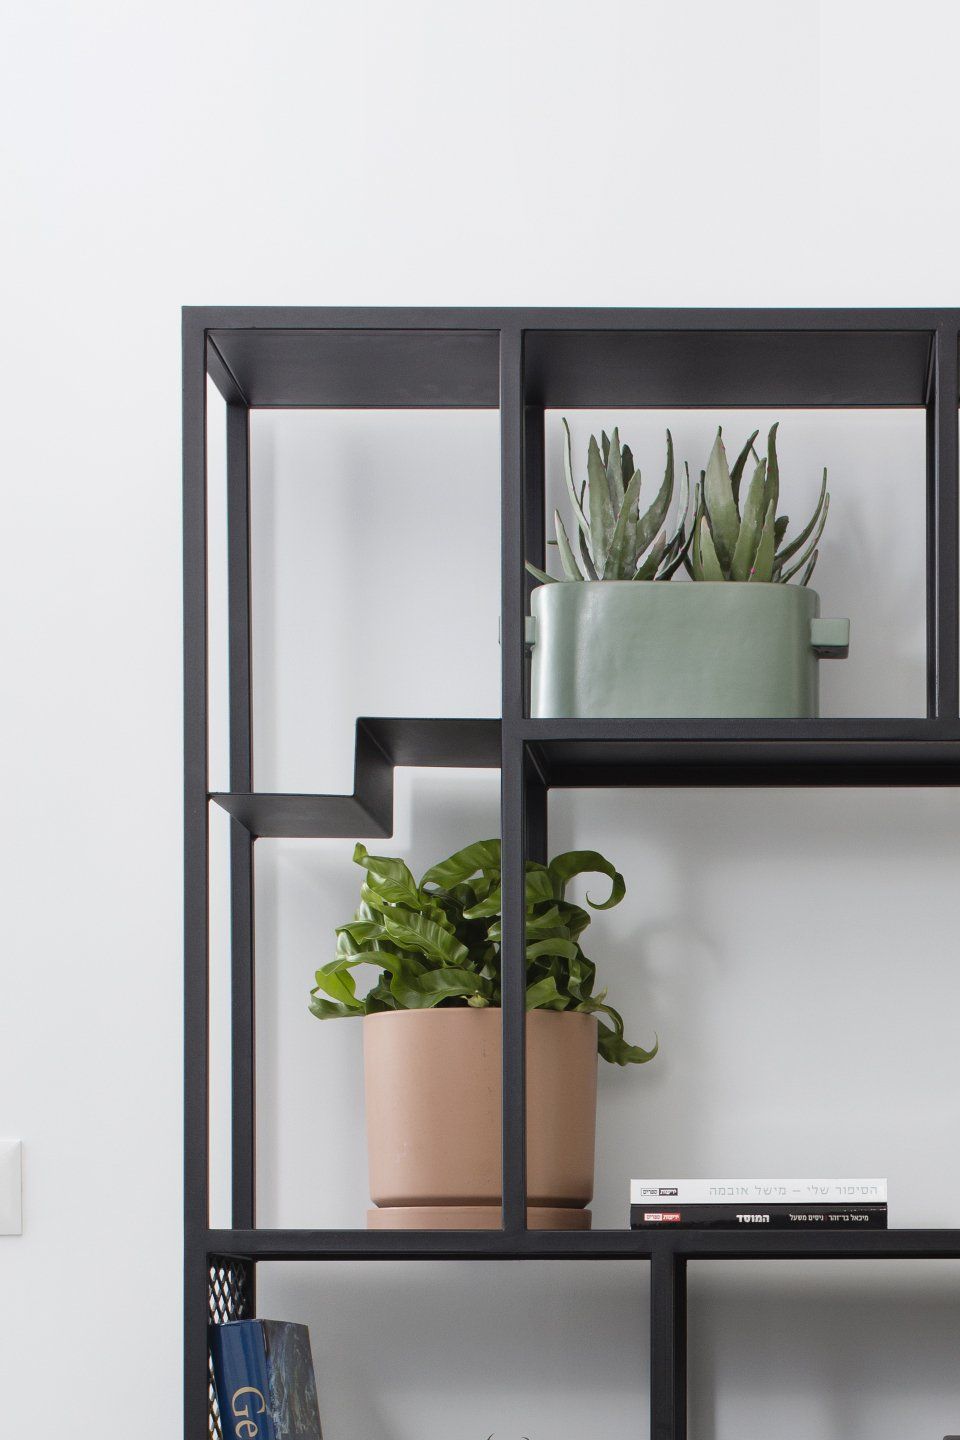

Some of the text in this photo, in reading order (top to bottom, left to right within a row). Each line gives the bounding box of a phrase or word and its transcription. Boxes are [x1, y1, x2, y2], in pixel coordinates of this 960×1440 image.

[709, 1186, 749, 1196] אובמה
[754, 1184, 787, 1196] מישל
[806, 1184, 830, 1195] שלי
[835, 1186, 878, 1195] הסיפור
[736, 1214, 770, 1223] המוסד
[850, 1213, 869, 1221] מיכאל
